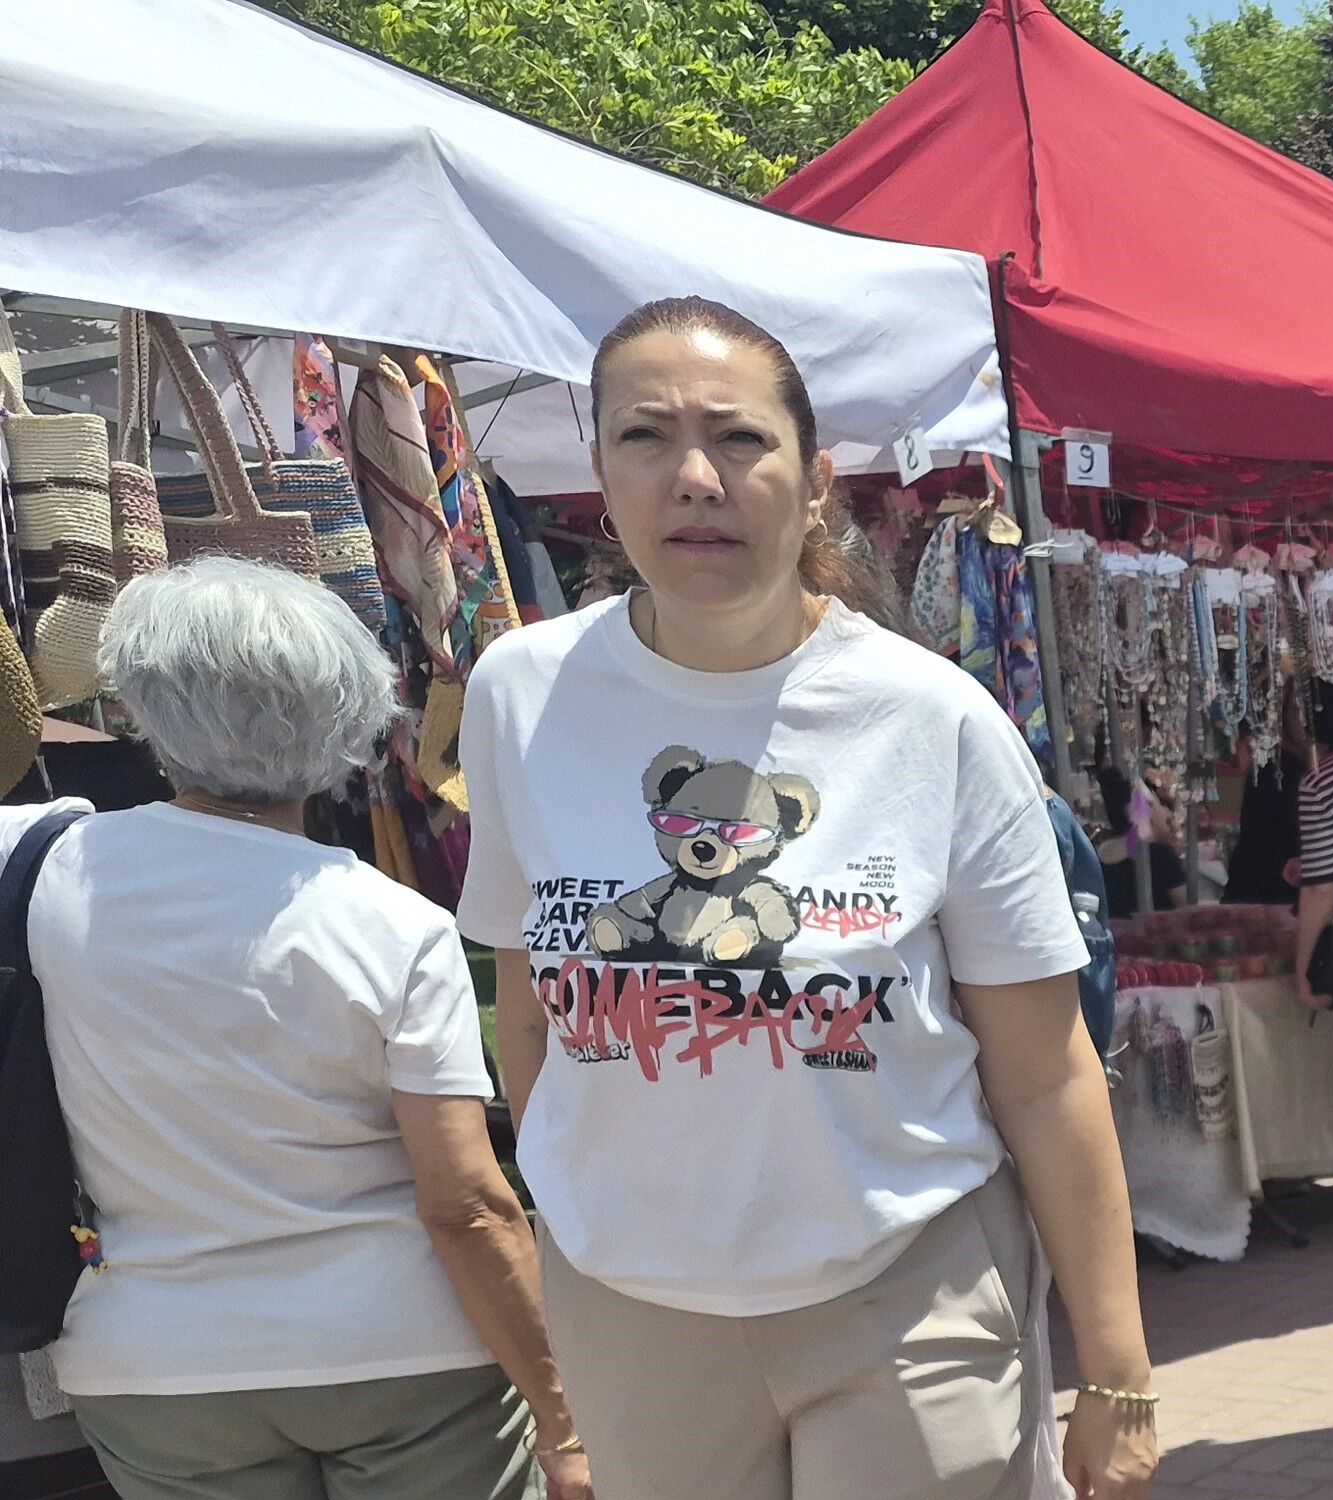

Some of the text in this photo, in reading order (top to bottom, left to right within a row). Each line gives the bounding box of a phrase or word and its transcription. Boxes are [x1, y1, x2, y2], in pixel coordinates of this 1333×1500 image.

[904, 434, 920, 471] 8
[1078, 444, 1095, 474] 9
[846, 862, 896, 871] SEASON
[866, 872, 895, 880] NEW
